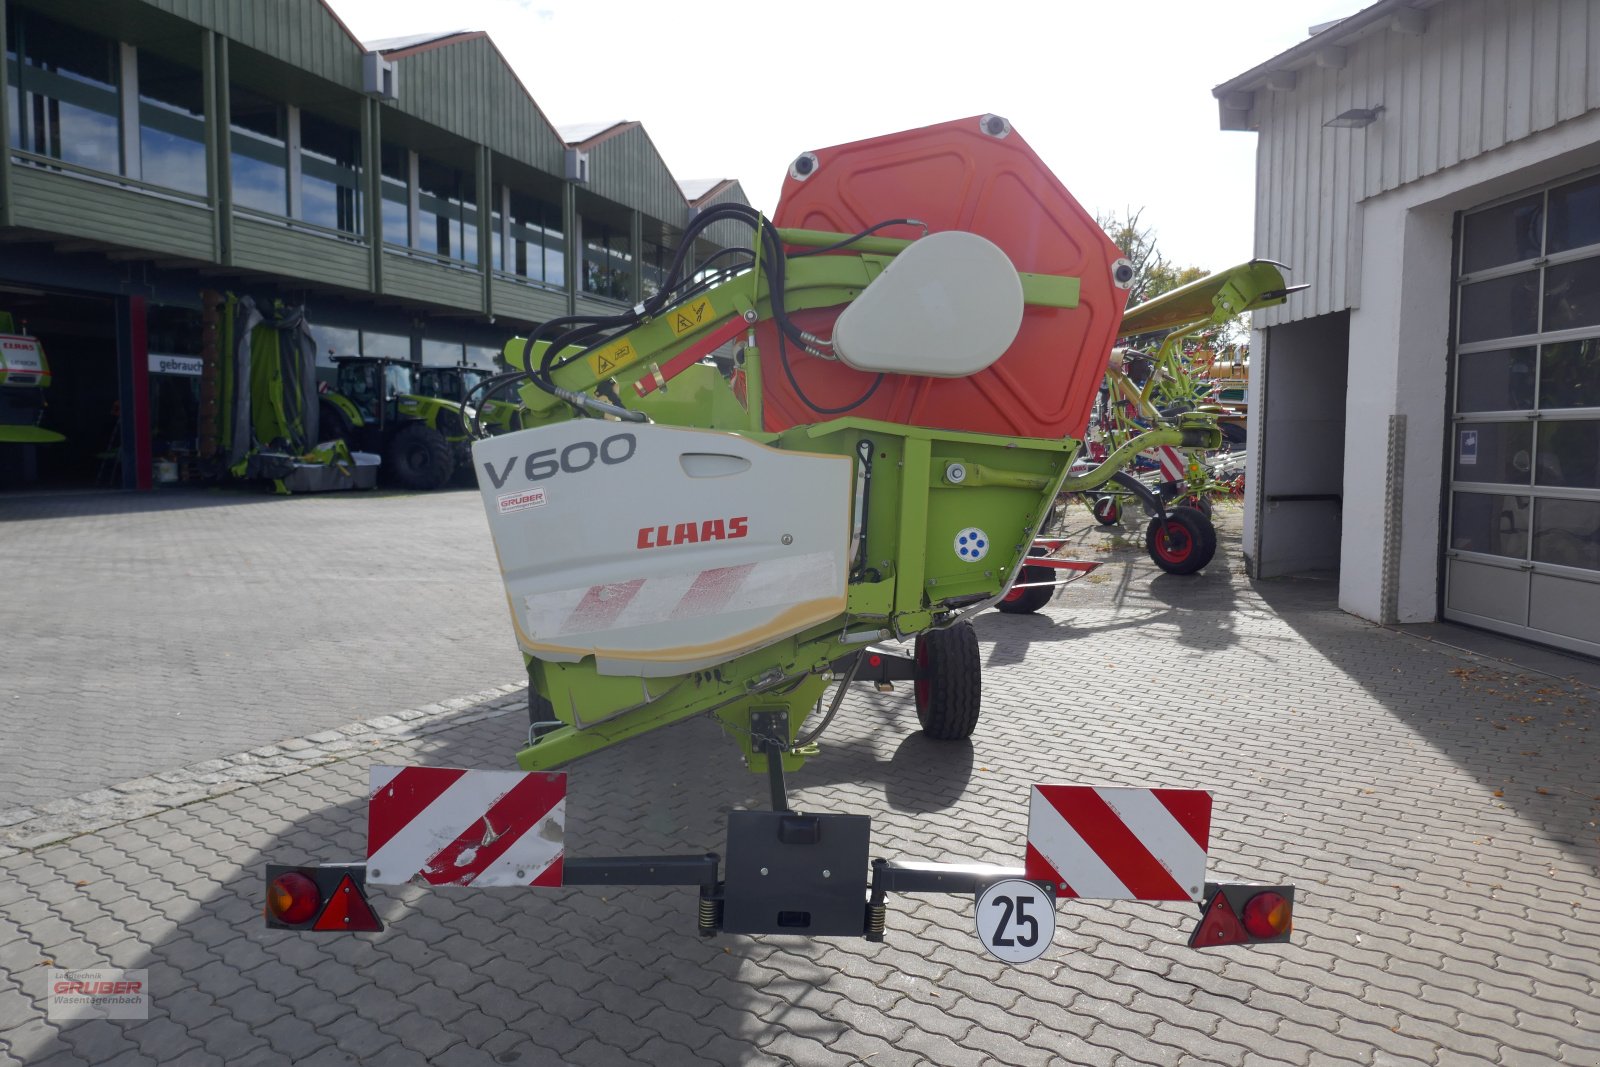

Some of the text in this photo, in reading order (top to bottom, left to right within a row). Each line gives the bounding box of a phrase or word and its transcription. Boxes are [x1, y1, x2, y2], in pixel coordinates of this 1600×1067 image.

[484, 432, 637, 489] V 600
[501, 493, 543, 507] GRUBER
[637, 516, 748, 549] CLAAS
[992, 895, 1039, 947] 25
